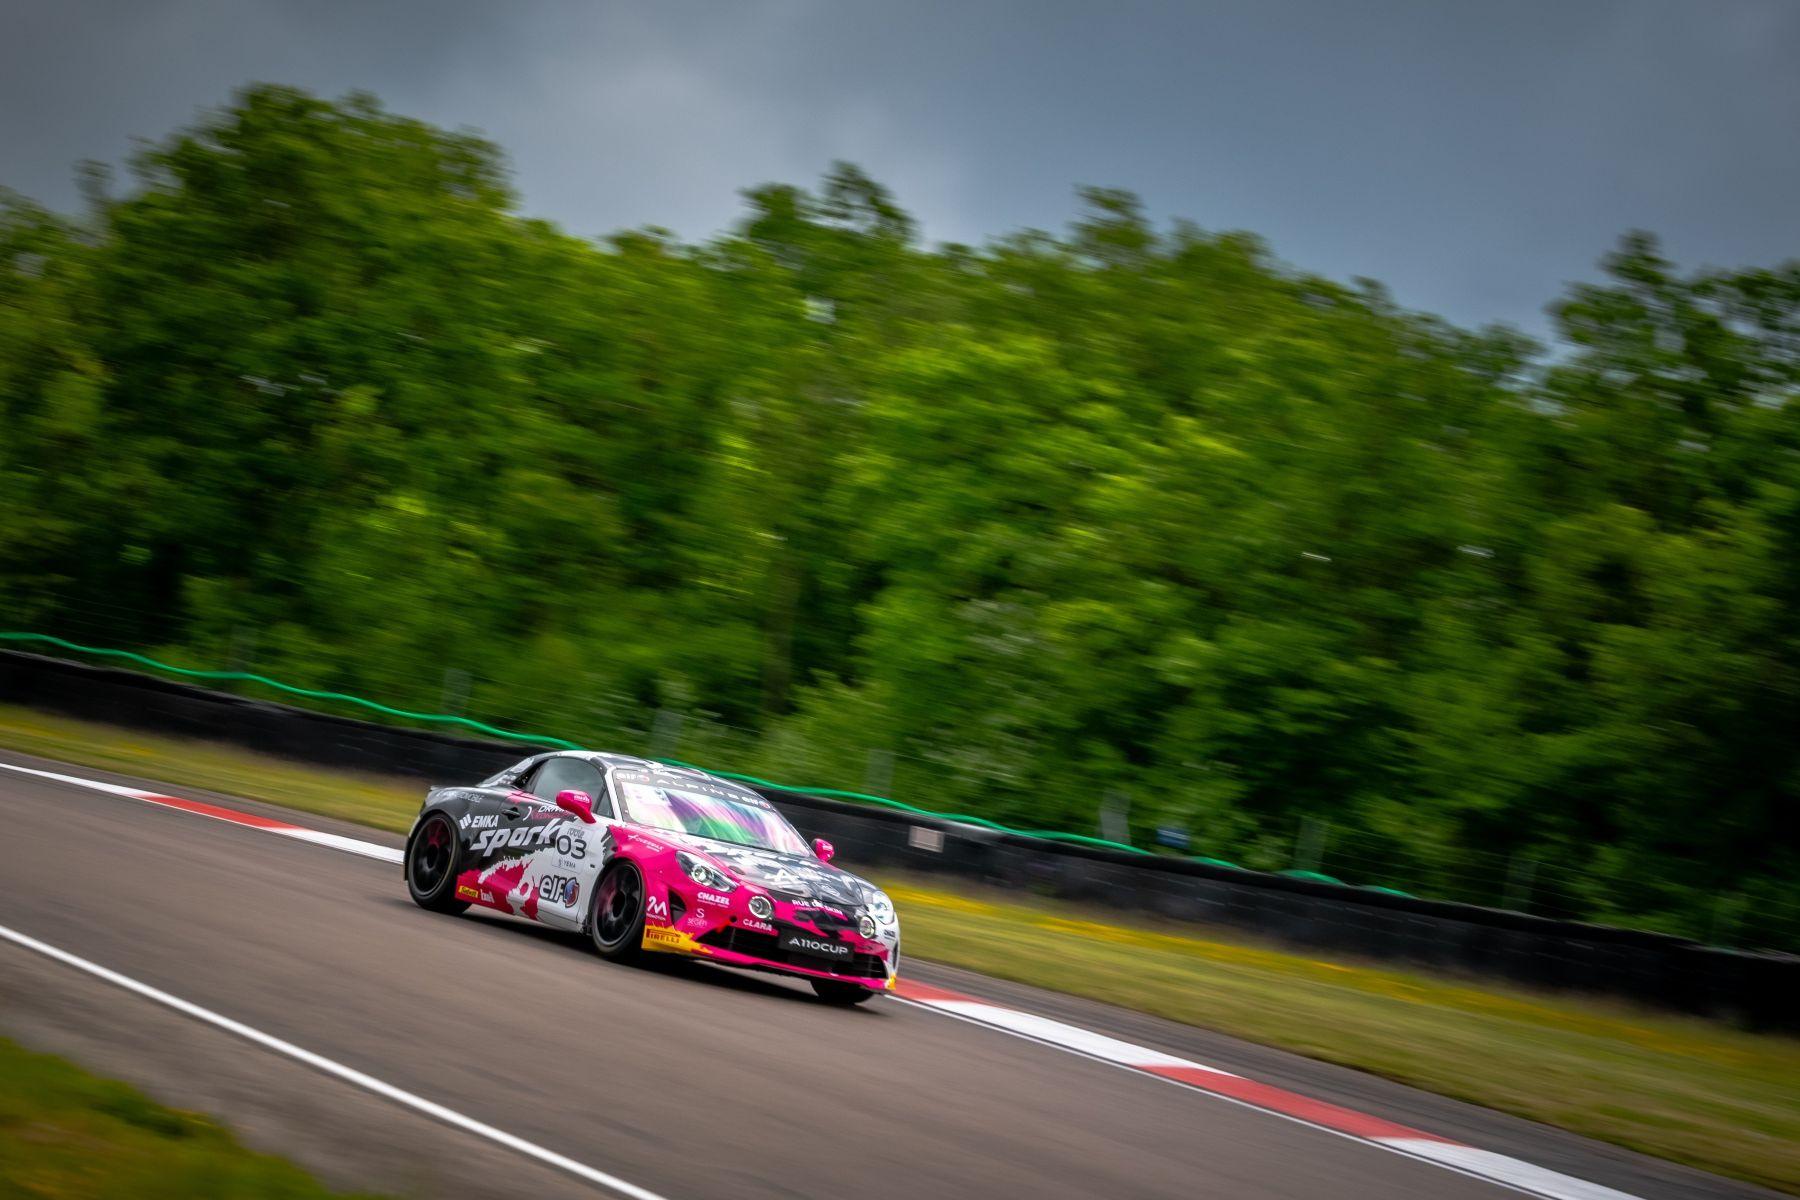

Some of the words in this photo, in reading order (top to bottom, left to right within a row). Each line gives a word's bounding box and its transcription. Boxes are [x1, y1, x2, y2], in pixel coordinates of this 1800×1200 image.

[471, 815, 499, 828] EMKA
[470, 818, 561, 857] spark
[556, 834, 587, 859] 03
[539, 874, 569, 903] elf
[697, 891, 730, 906] CHAZEL
[743, 918, 773, 932] CLARA
[646, 928, 681, 943] PIRELLI
[789, 938, 849, 955] A110CUP
